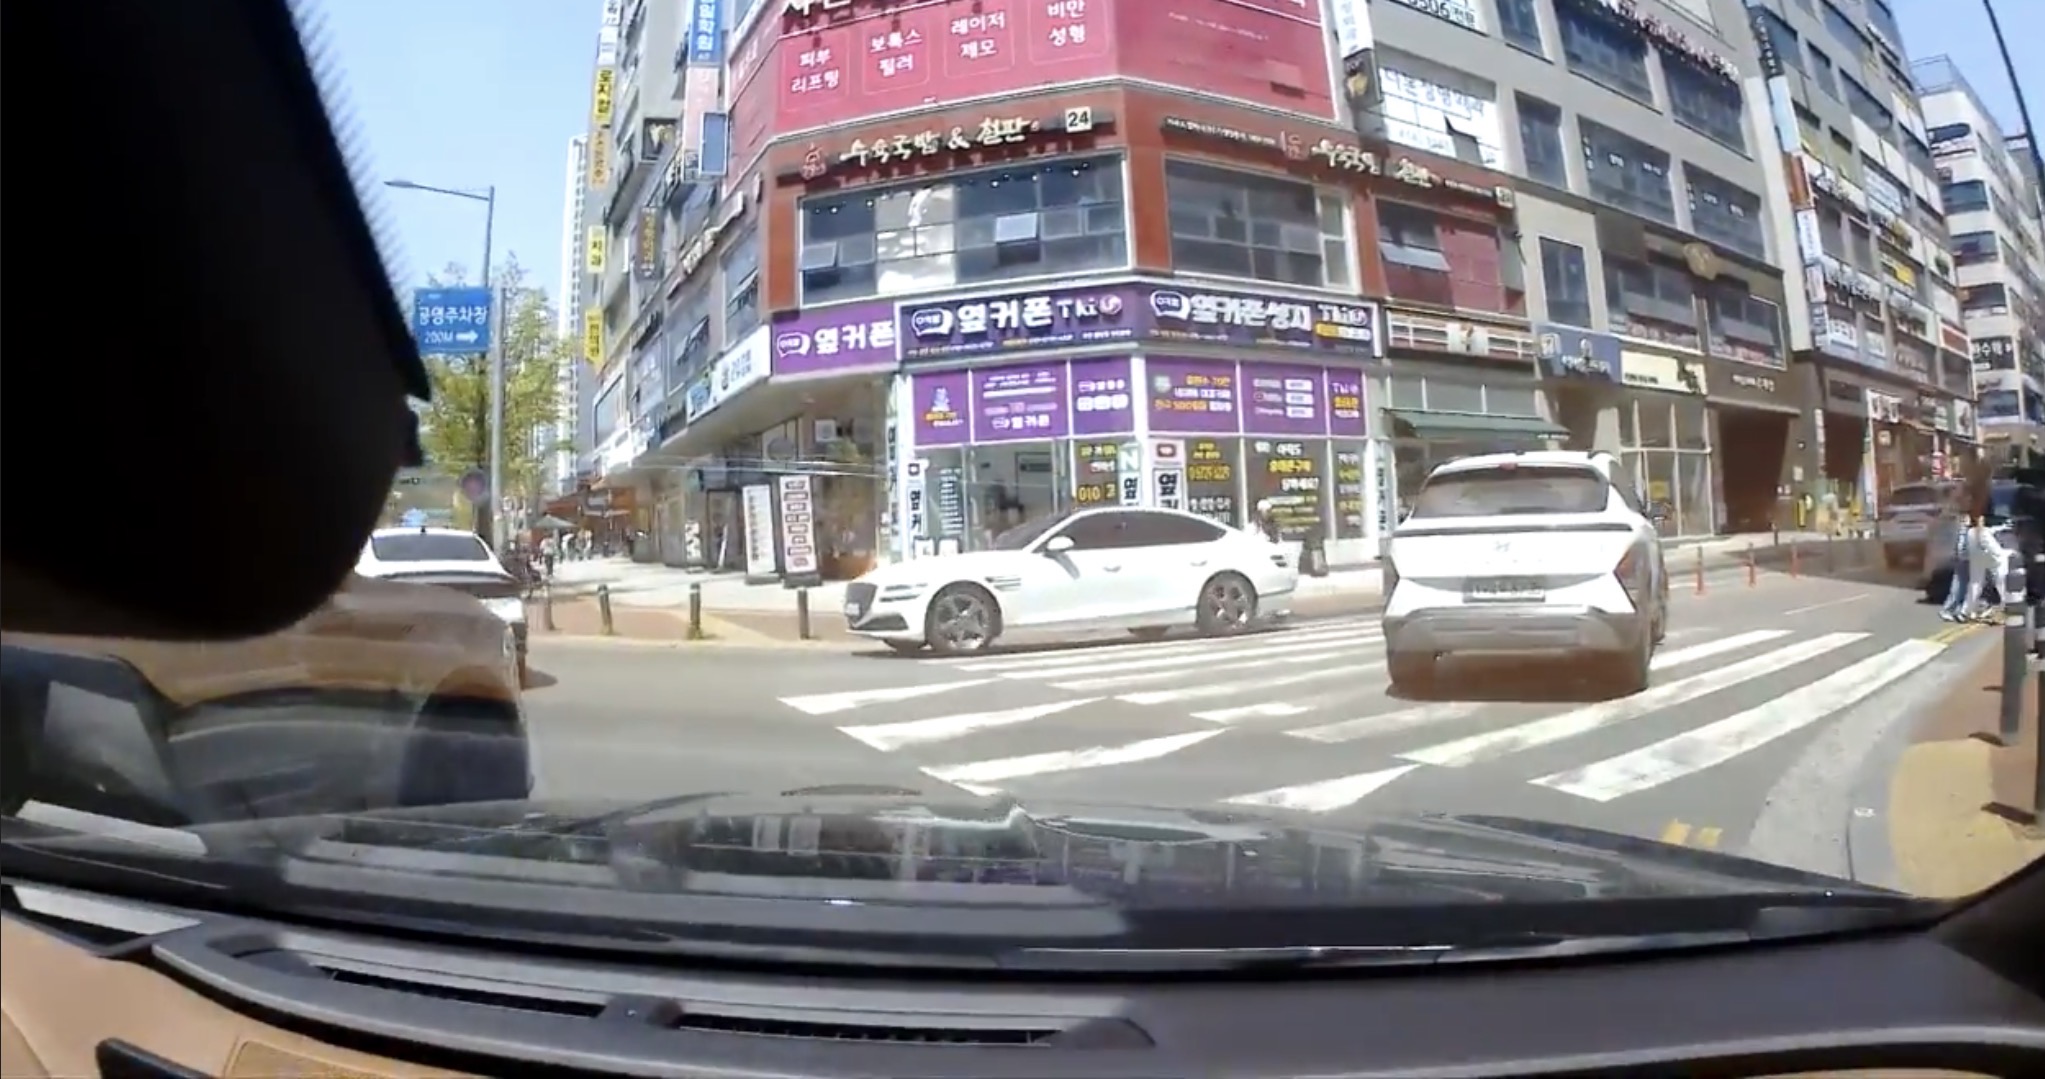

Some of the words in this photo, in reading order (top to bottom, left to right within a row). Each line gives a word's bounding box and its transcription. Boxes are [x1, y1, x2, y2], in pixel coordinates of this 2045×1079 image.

[1046, 0, 1086, 19] 비만
[951, 13, 1006, 36] 레이저
[1049, 24, 1087, 47] 성형
[869, 28, 923, 53] 보톡스
[960, 38, 998, 60] 제모
[799, 49, 831, 68] 피부
[879, 53, 914, 77] 필러
[791, 69, 840, 93] 리프팅
[839, 129, 941, 167] 수육국밥
[948, 126, 971, 150] &
[1067, 110, 1089, 127] 24
[418, 305, 488, 327] 공영주차장
[957, 296, 1053, 335] 옆커폰
[814, 320, 895, 356] 옆커폰
